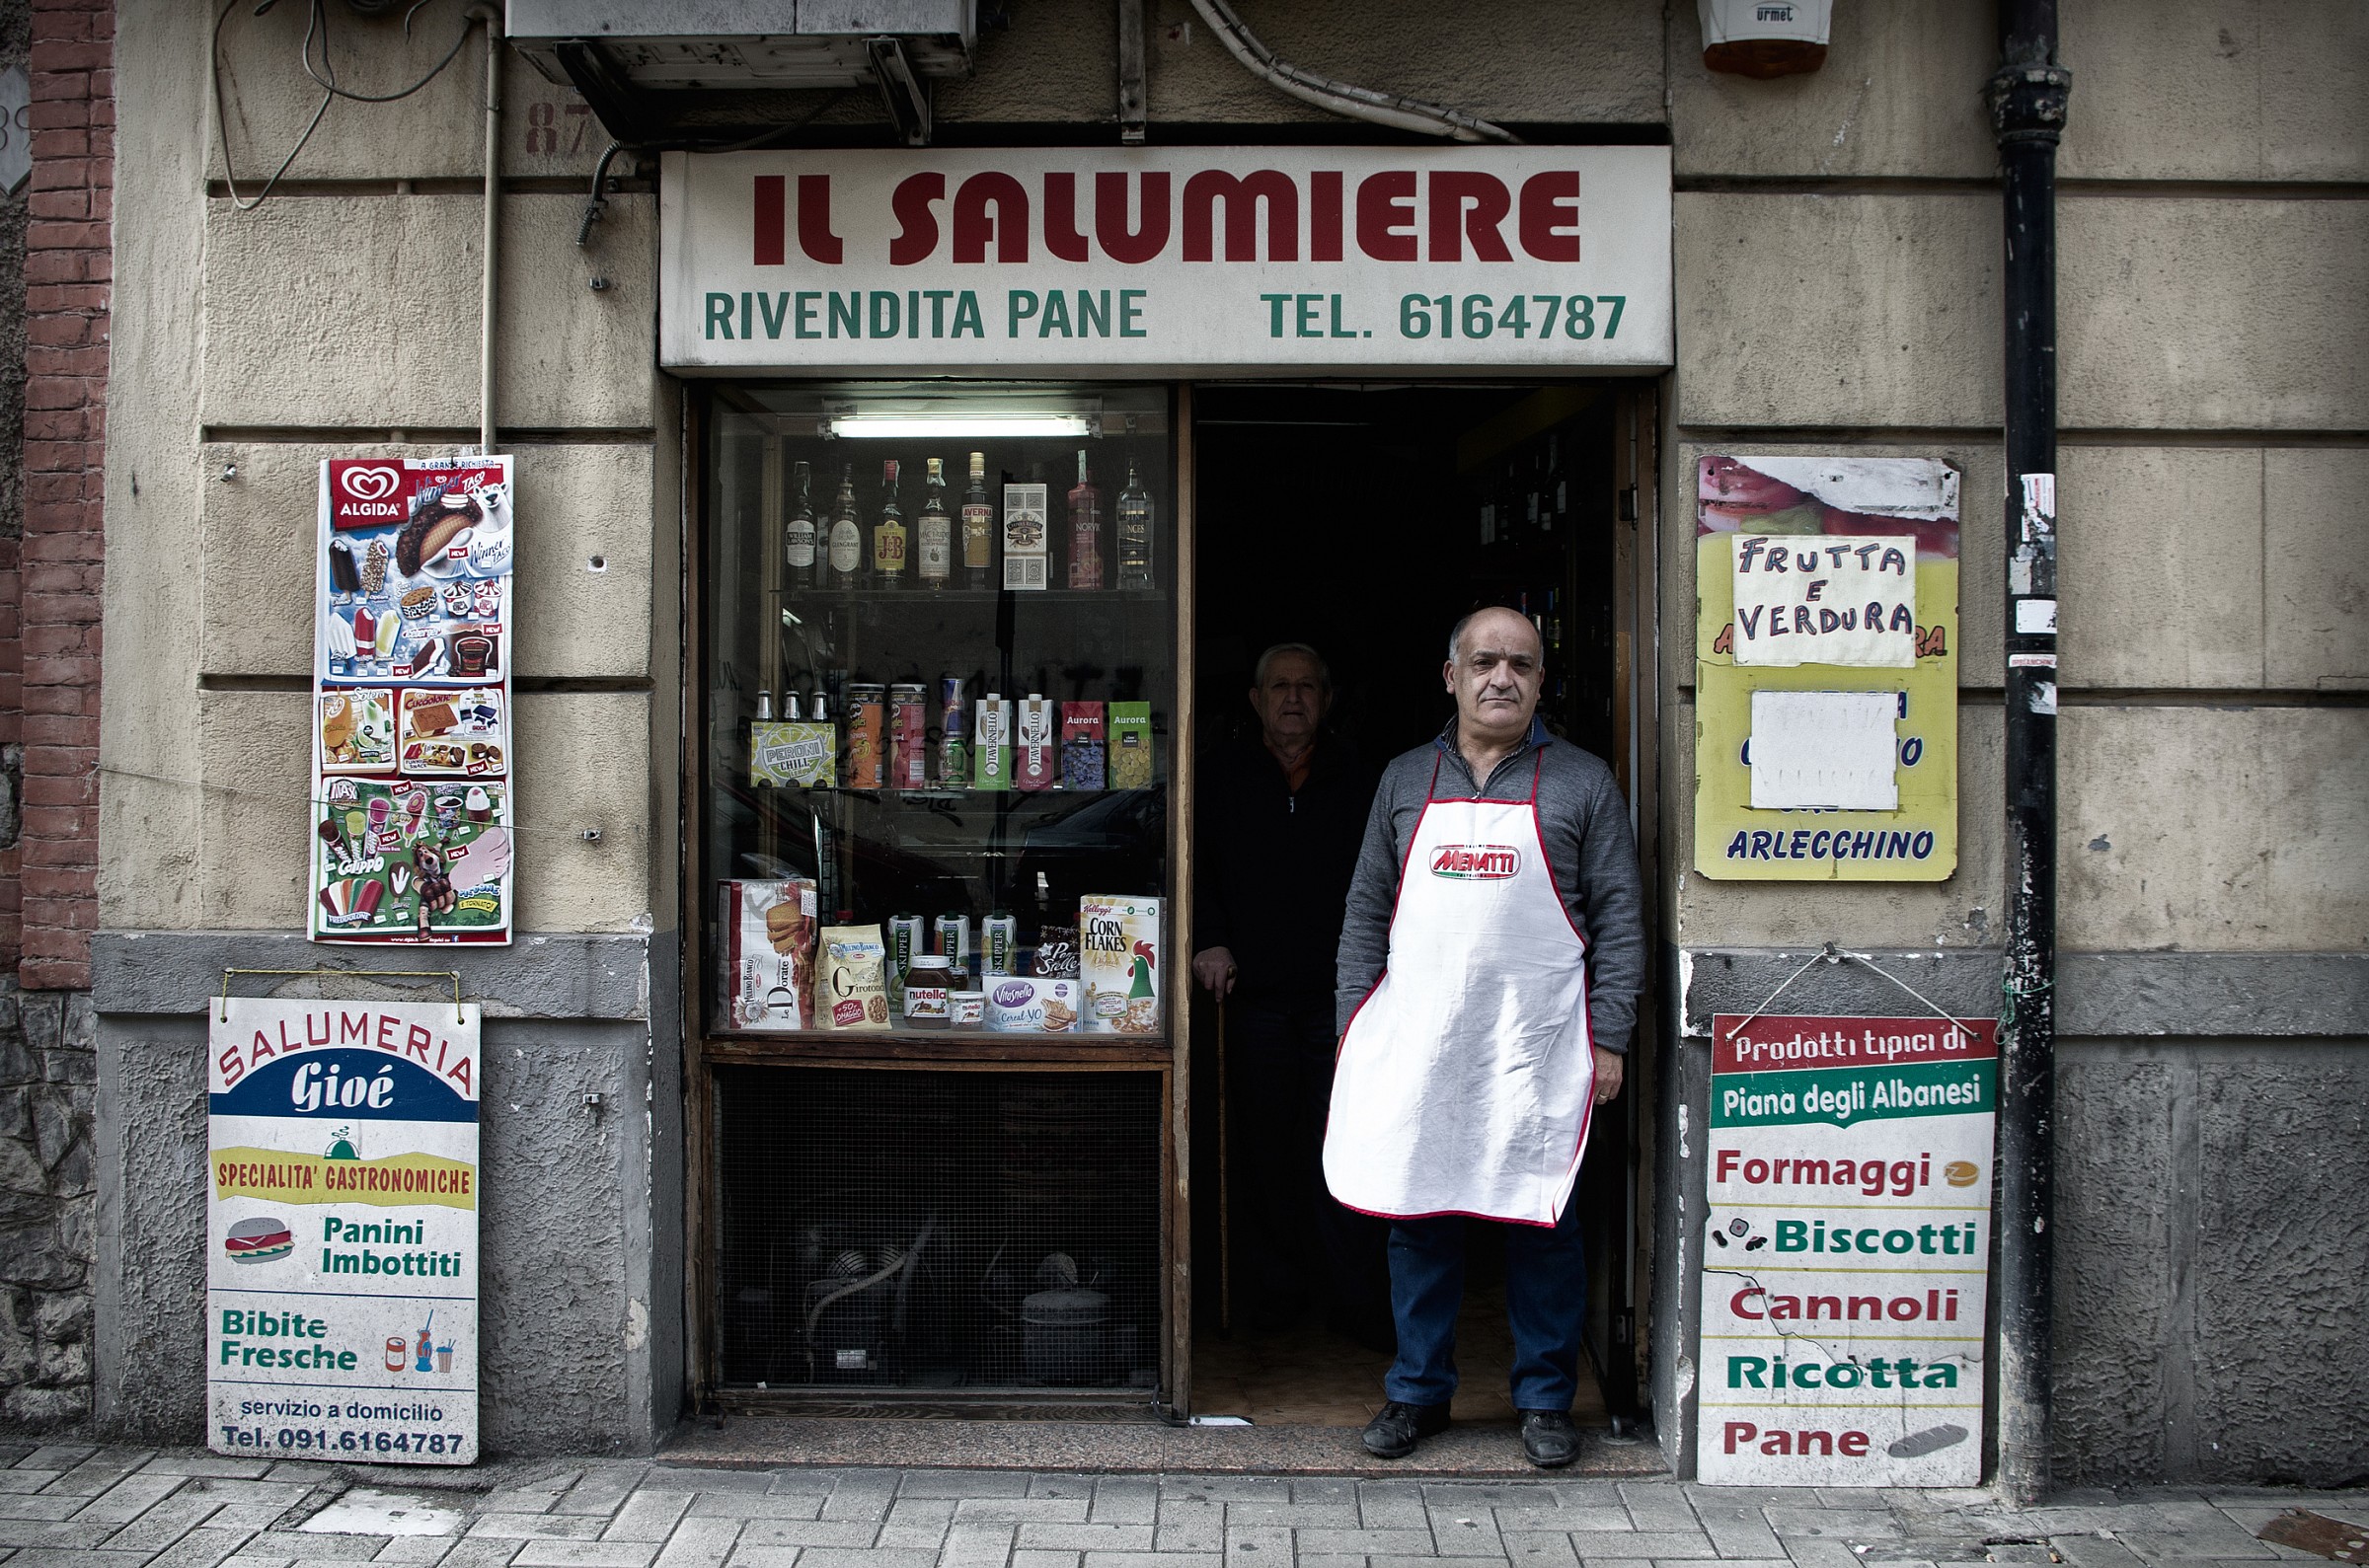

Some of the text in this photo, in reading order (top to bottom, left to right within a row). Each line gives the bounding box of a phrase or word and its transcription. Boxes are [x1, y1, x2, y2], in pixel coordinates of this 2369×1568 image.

[1756, 6, 1794, 22] urmet
[526, 102, 591, 156] 87
[754, 169, 1580, 265] IL SALUMIERE
[705, 289, 1627, 340] RIVENDITA PANE TEL. 6164787
[461, 459, 495, 469] RICHIESTA
[462, 471, 486, 493] TACO
[340, 503, 399, 516] ALGIDA
[1739, 537, 1906, 576] FRUTTA
[1805, 579, 1829, 602] E
[1737, 601, 1913, 641] VERDURA
[350, 687, 385, 703] Solero
[405, 694, 452, 710] Cucciolone
[1113, 715, 1146, 724] Aurora
[988, 712, 998, 763] TAVERNELLO
[1031, 712, 1039, 763] TAVERNELLO
[766, 742, 820, 763] PERONI
[780, 758, 809, 771] CHILL
[469, 764, 486, 774] NEW
[330, 783, 356, 800] MAX
[394, 784, 410, 793] NEW
[1726, 830, 1934, 860] ARLECCHINO
[1433, 850, 1514, 873] MENATTI
[1083, 904, 1112, 916] Kellogg's
[1090, 918, 1123, 935] CORN
[899, 931, 908, 971] SKIPPER
[947, 932, 955, 968] KIPPER
[1085, 933, 1127, 952] FLAKES
[1036, 955, 1078, 974] Stelle
[767, 960, 793, 1009] Dorate
[909, 989, 947, 1000] nutella
[996, 985, 1032, 1005] Vitasnella
[782, 1008, 789, 1019] Le
[836, 1008, 862, 1021] OMAGGIO
[218, 1010, 471, 1097] SALUMERIA
[1735, 1024, 1966, 1062] Prodotti tipici di
[1723, 1073, 1980, 1120] Piana degli Albanesi
[218, 1162, 470, 1194] SPECIALITA' GASTRONOMICHE
[1716, 1149, 1931, 1197] Formaggi
[323, 1217, 423, 1244] Panini
[1775, 1220, 1976, 1255] Biscotti
[322, 1247, 461, 1277] Imbottiti
[1729, 1287, 1958, 1321] Cannoli
[222, 1309, 328, 1339] Bibite
[220, 1340, 358, 1371] Fresche
[1727, 1355, 1957, 1389] Ricotta
[241, 1399, 443, 1421] servizio a domicilio
[221, 1425, 463, 1455] Tel. 091.6164787
[1723, 1421, 1871, 1456] Pane
